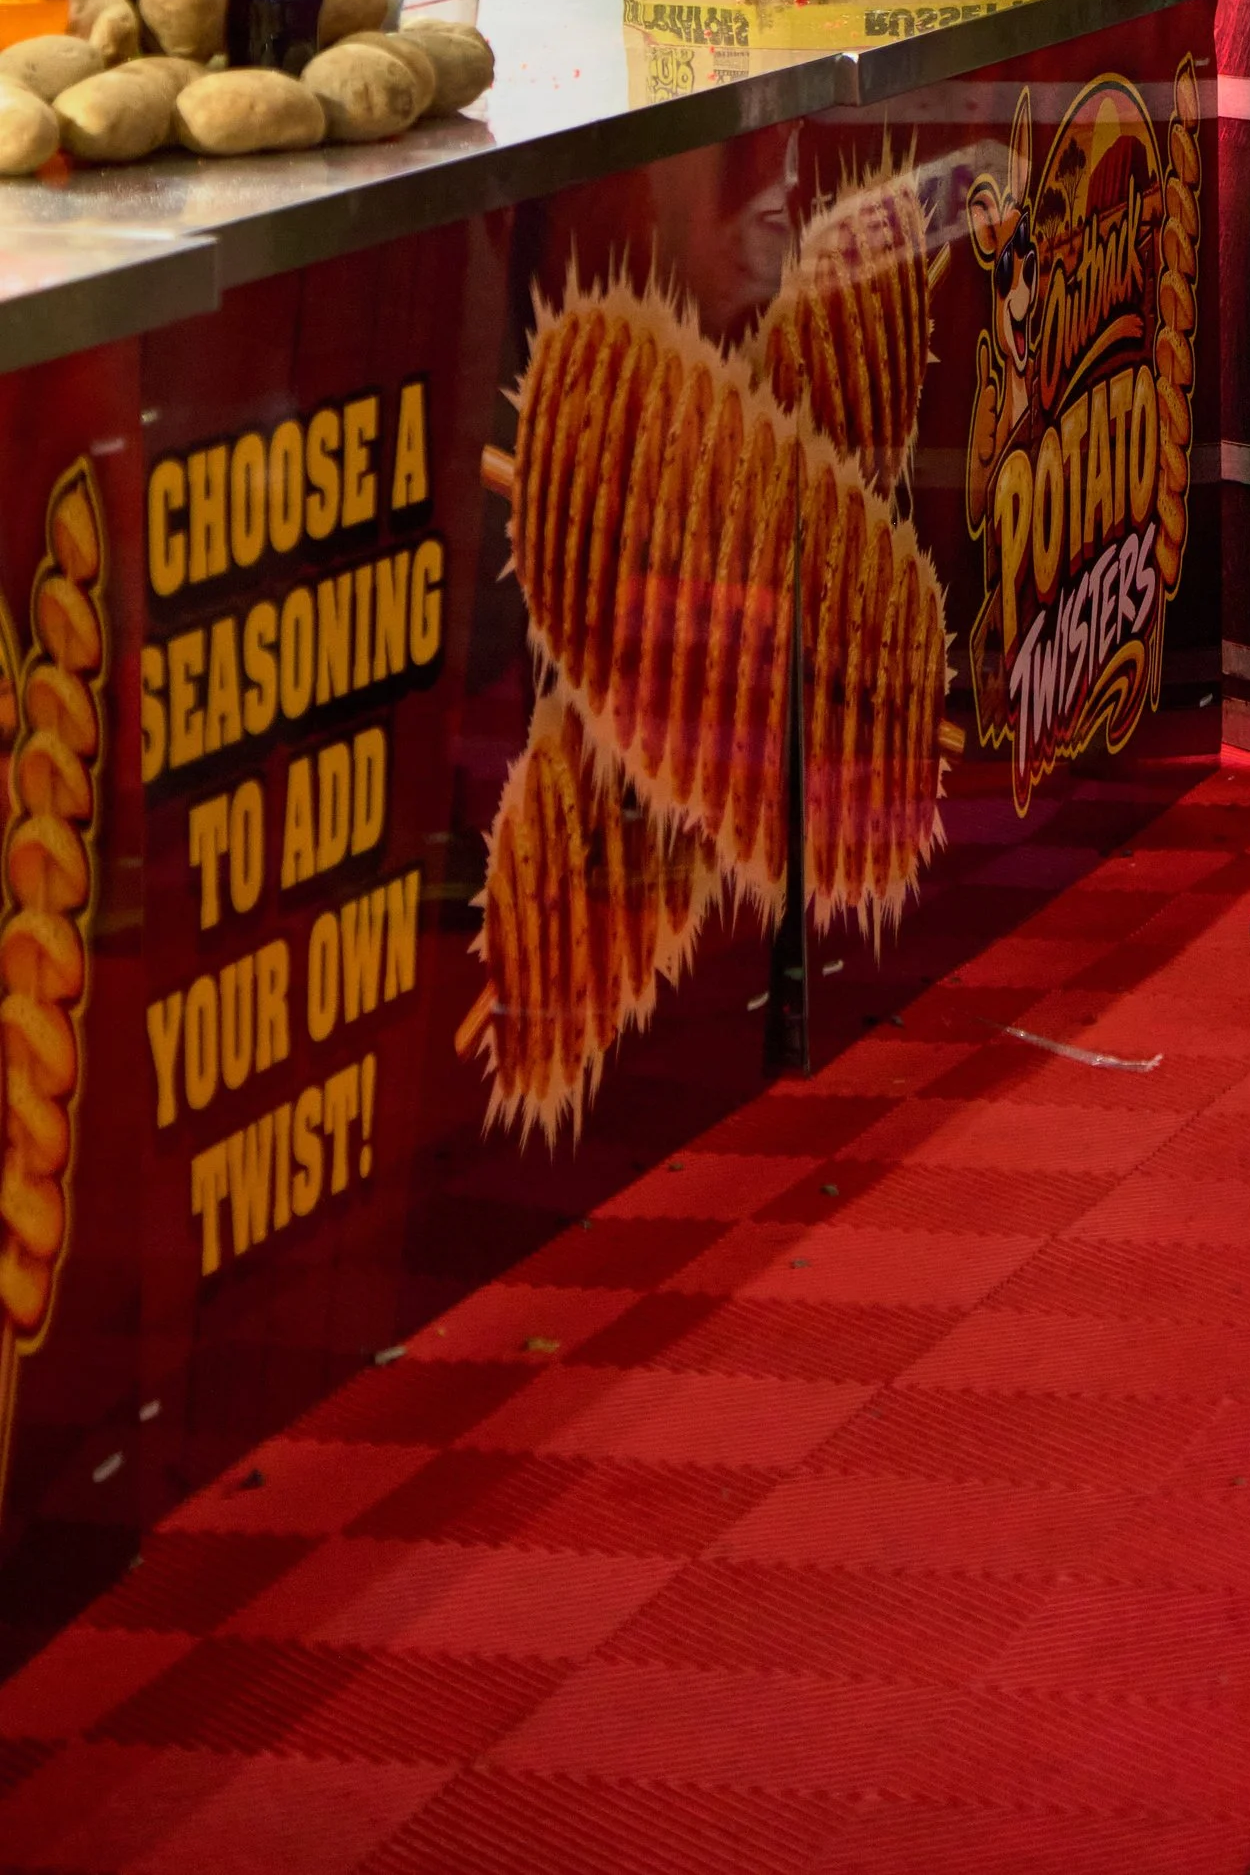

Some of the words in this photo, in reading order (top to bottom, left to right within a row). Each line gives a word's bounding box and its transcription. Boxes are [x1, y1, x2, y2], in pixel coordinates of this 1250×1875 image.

[1040, 190, 1145, 410] Outback
[147, 395, 382, 600] CHOOSE
[391, 382, 431, 509] A
[996, 364, 1160, 660] POTATO
[142, 540, 445, 786] SEASONING
[1010, 522, 1157, 773] TWISTERS
[190, 779, 263, 932] TO
[282, 727, 388, 890] ADD
[146, 940, 291, 1129] YOUR
[307, 871, 423, 1043] OWN
[192, 1053, 378, 1278] TWIST!
